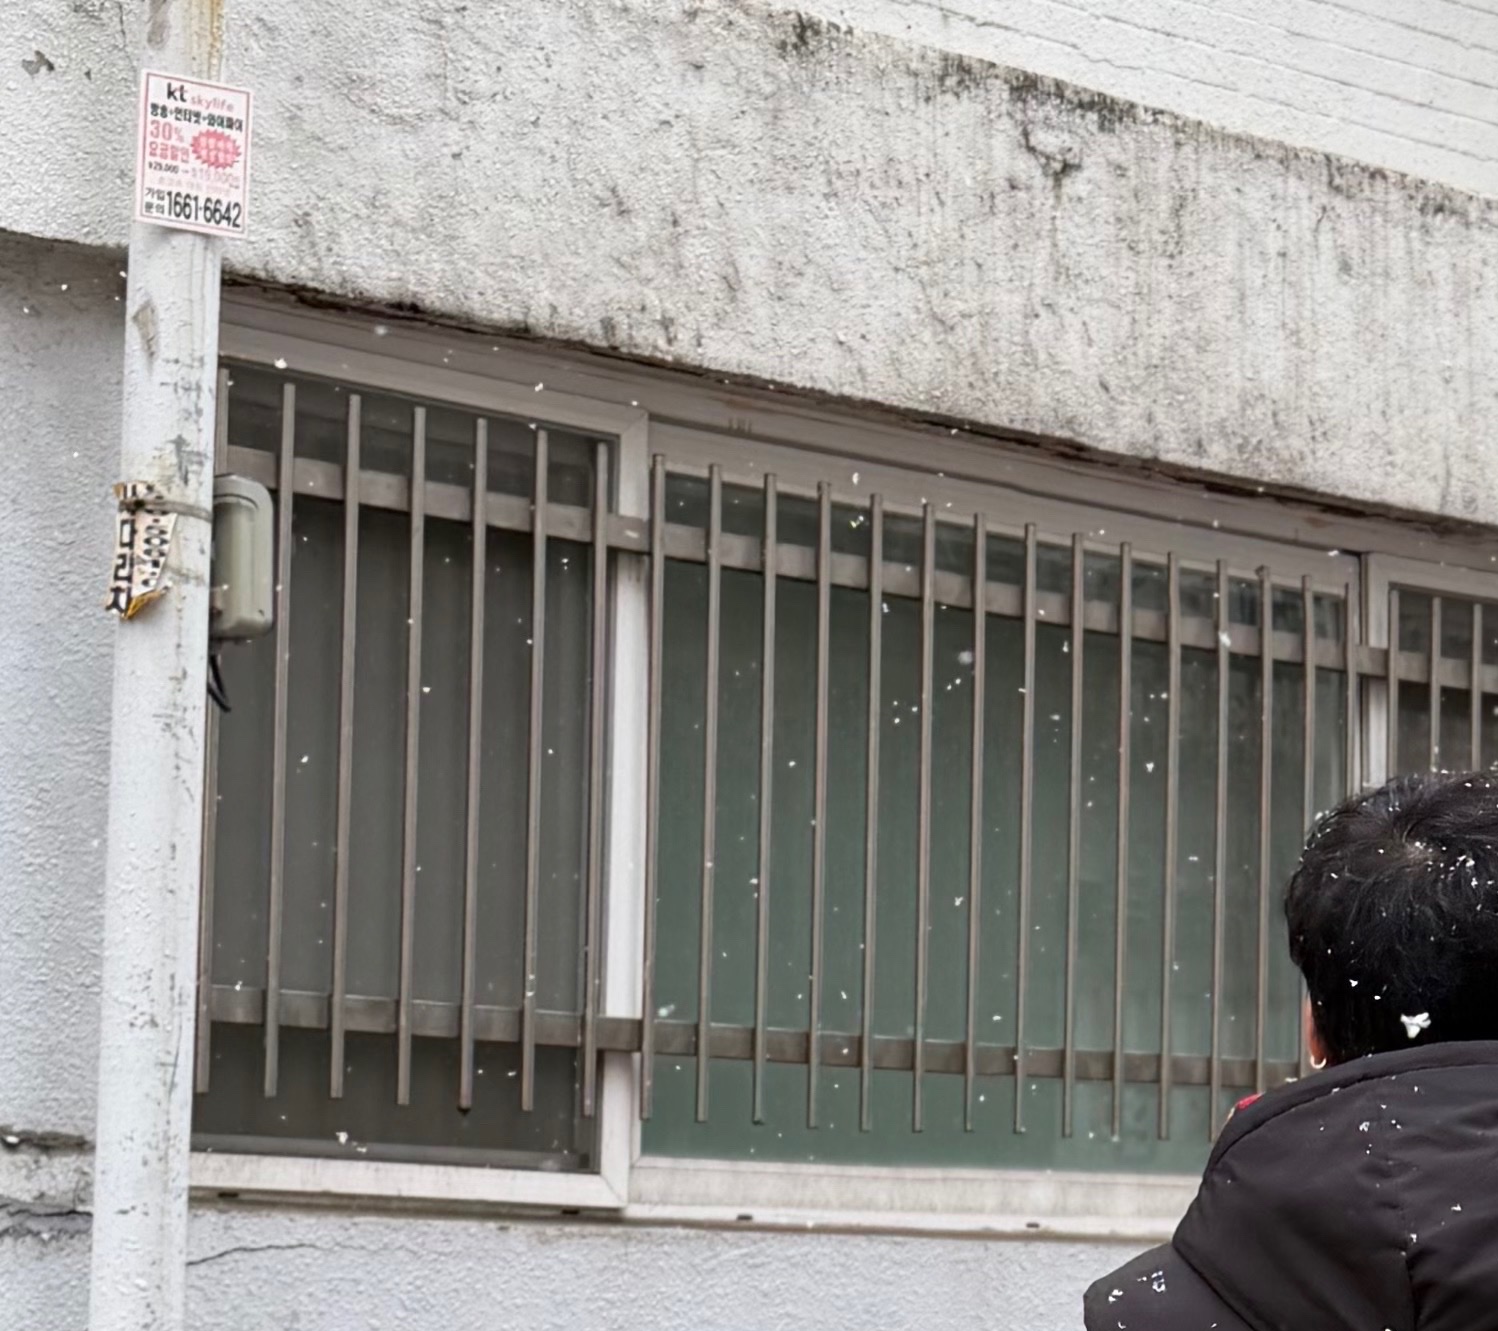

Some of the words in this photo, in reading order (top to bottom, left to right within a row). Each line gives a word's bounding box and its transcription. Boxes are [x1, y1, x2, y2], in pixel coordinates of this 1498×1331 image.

[167, 82, 188, 102] kt
[191, 95, 234, 113] skylife
[150, 119, 185, 143] 30%
[166, 190, 242, 229] 1661-6642
